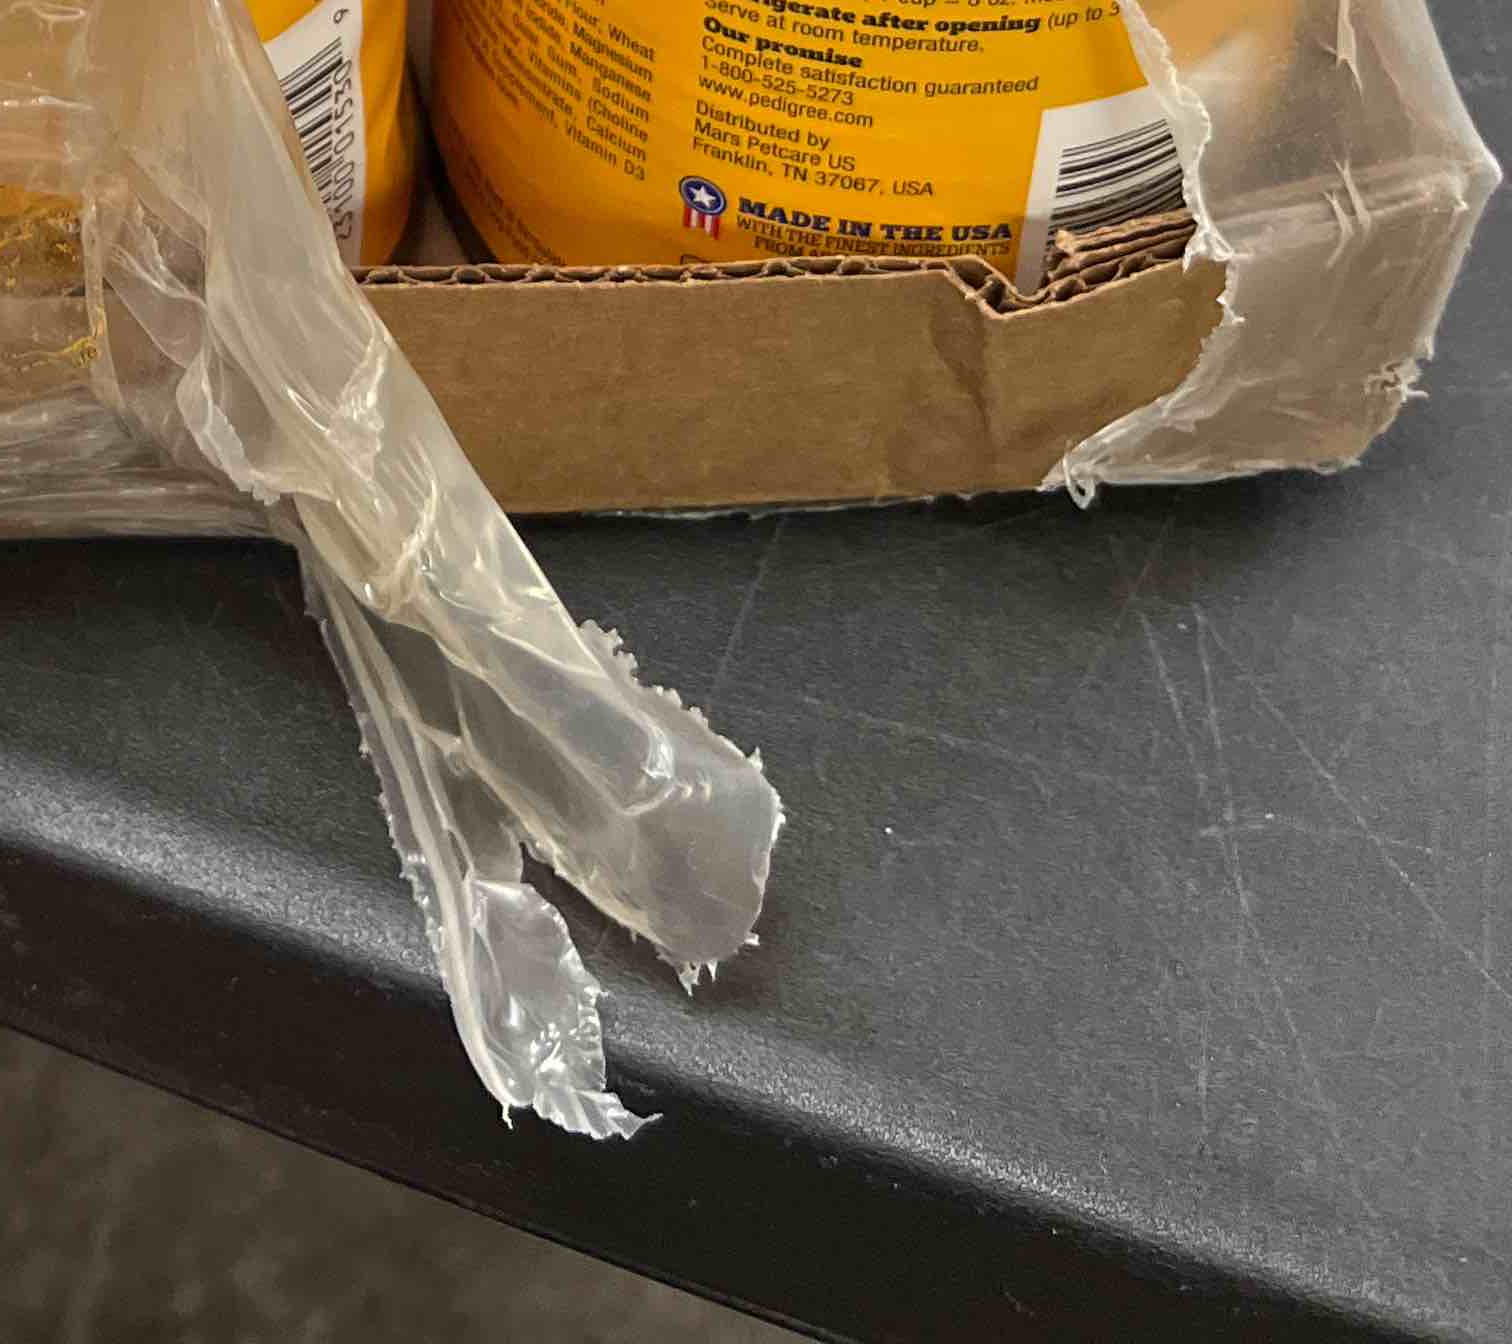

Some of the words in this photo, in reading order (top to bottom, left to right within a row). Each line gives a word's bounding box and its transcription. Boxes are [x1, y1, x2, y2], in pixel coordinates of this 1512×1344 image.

[607, 21, 654, 65] Wheat
[703, 15, 751, 44] Our
[755, 35, 864, 69] promise
[765, 13, 785, 30] at
[791, 18, 844, 43] room
[851, 28, 986, 53] temperature.
[861, 11, 929, 32] after
[934, 14, 1042, 37] opening
[1046, 10, 1079, 33] (up
[1084, 6, 1103, 23] to
[1109, 0, 1121, 17] 3
[568, 38, 652, 104] Manganese
[573, 19, 652, 86] Magnesium
[701, 35, 794, 75] Complete
[799, 64, 918, 94] satisfaction
[923, 75, 1041, 98] guaranteed
[591, 73, 649, 125] Sodium
[697, 74, 874, 129] www.pedigree.com
[701, 55, 855, 106] 1-800-525-5273
[586, 111, 647, 165] Calcium
[587, 92, 648, 146] (Choline
[693, 117, 741, 147] Mars
[746, 135, 822, 165] Petcare
[827, 153, 856, 172] US
[695, 98, 801, 144] Distributed
[806, 131, 831, 151] by
[565, 117, 616, 169] Vitamin
[623, 154, 645, 184] D3
[691, 137, 774, 177] Franklin,
[781, 163, 809, 183] TN
[814, 170, 885, 196] 37067,
[891, 180, 934, 197] USA
[736, 215, 786, 241] WITH
[787, 229, 823, 248] THE
[824, 234, 889, 256] FINEST
[892, 239, 1010, 257] INGREDIENTS
[737, 196, 831, 232] MADE
[838, 218, 873, 239] IN
[879, 223, 945, 242] THE
[951, 222, 1013, 241] USA
[754, 236, 805, 258] FROM
